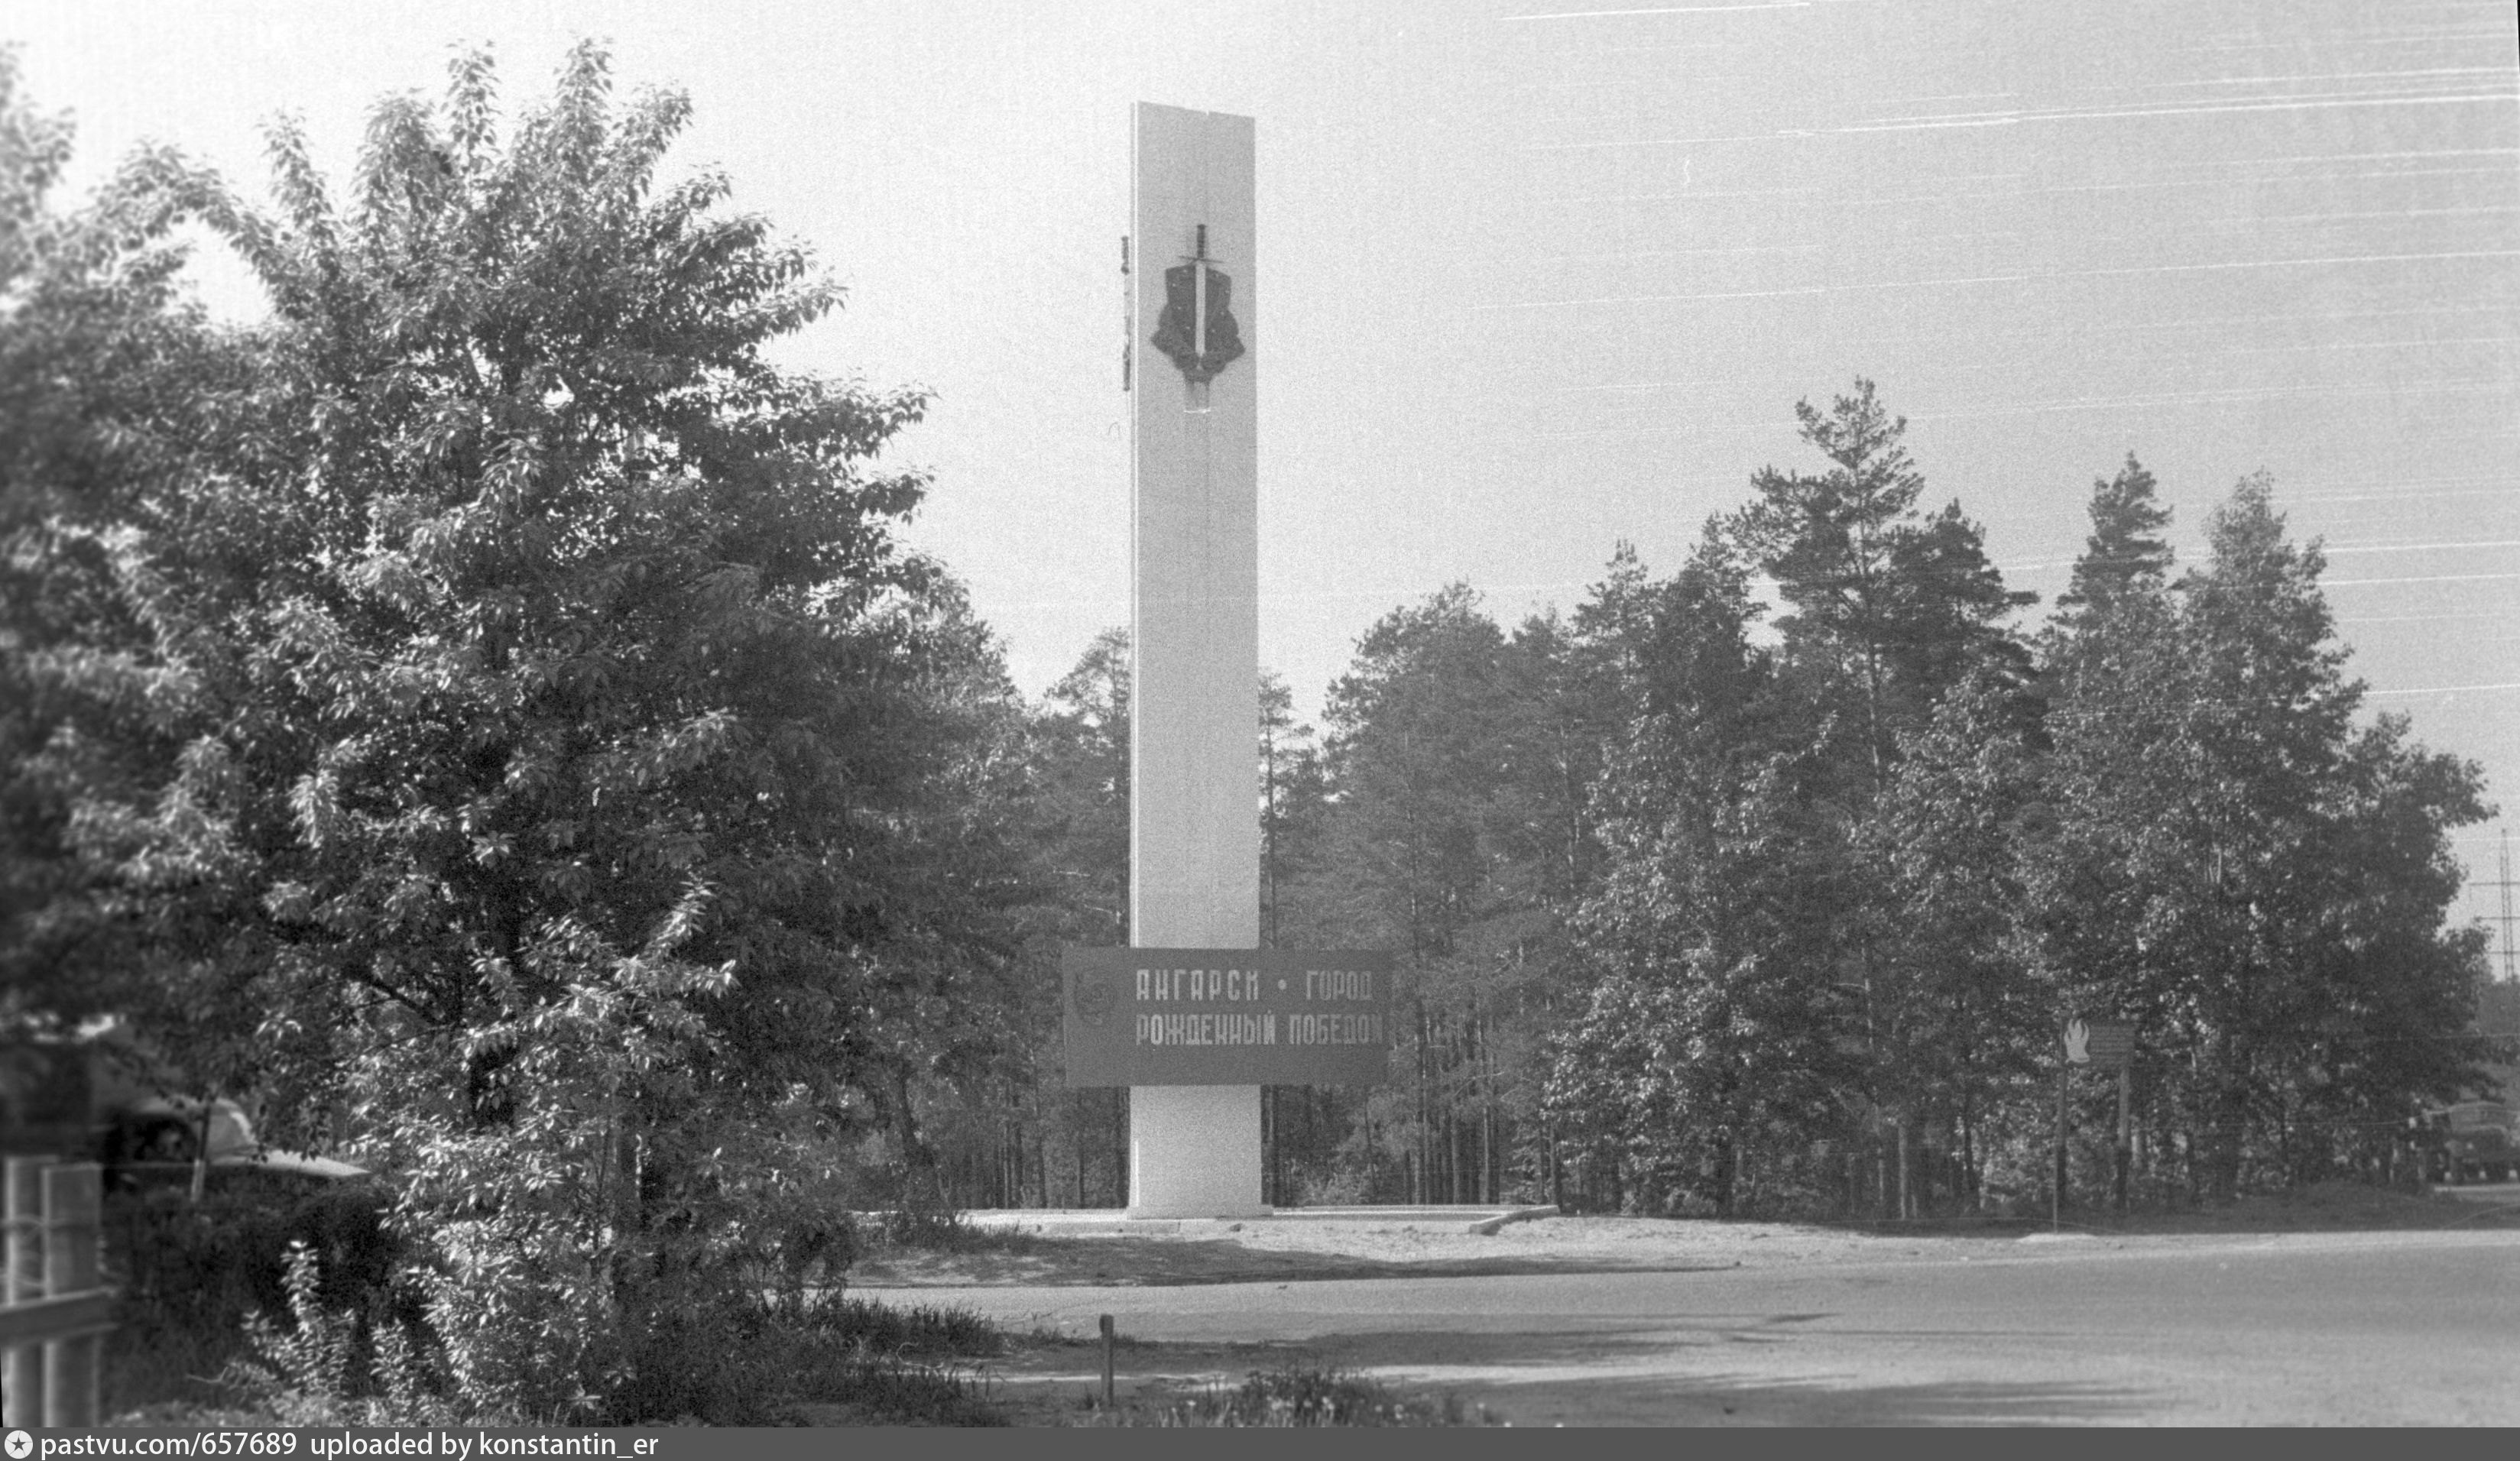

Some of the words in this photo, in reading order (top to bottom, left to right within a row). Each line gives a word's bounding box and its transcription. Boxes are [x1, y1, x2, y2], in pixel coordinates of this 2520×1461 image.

[1137, 969, 1260, 1001] АНГАРСК
[1306, 970, 1373, 1001] ГОРОД
[1137, 1010, 1276, 1045] РОЖДЕННЫЙ
